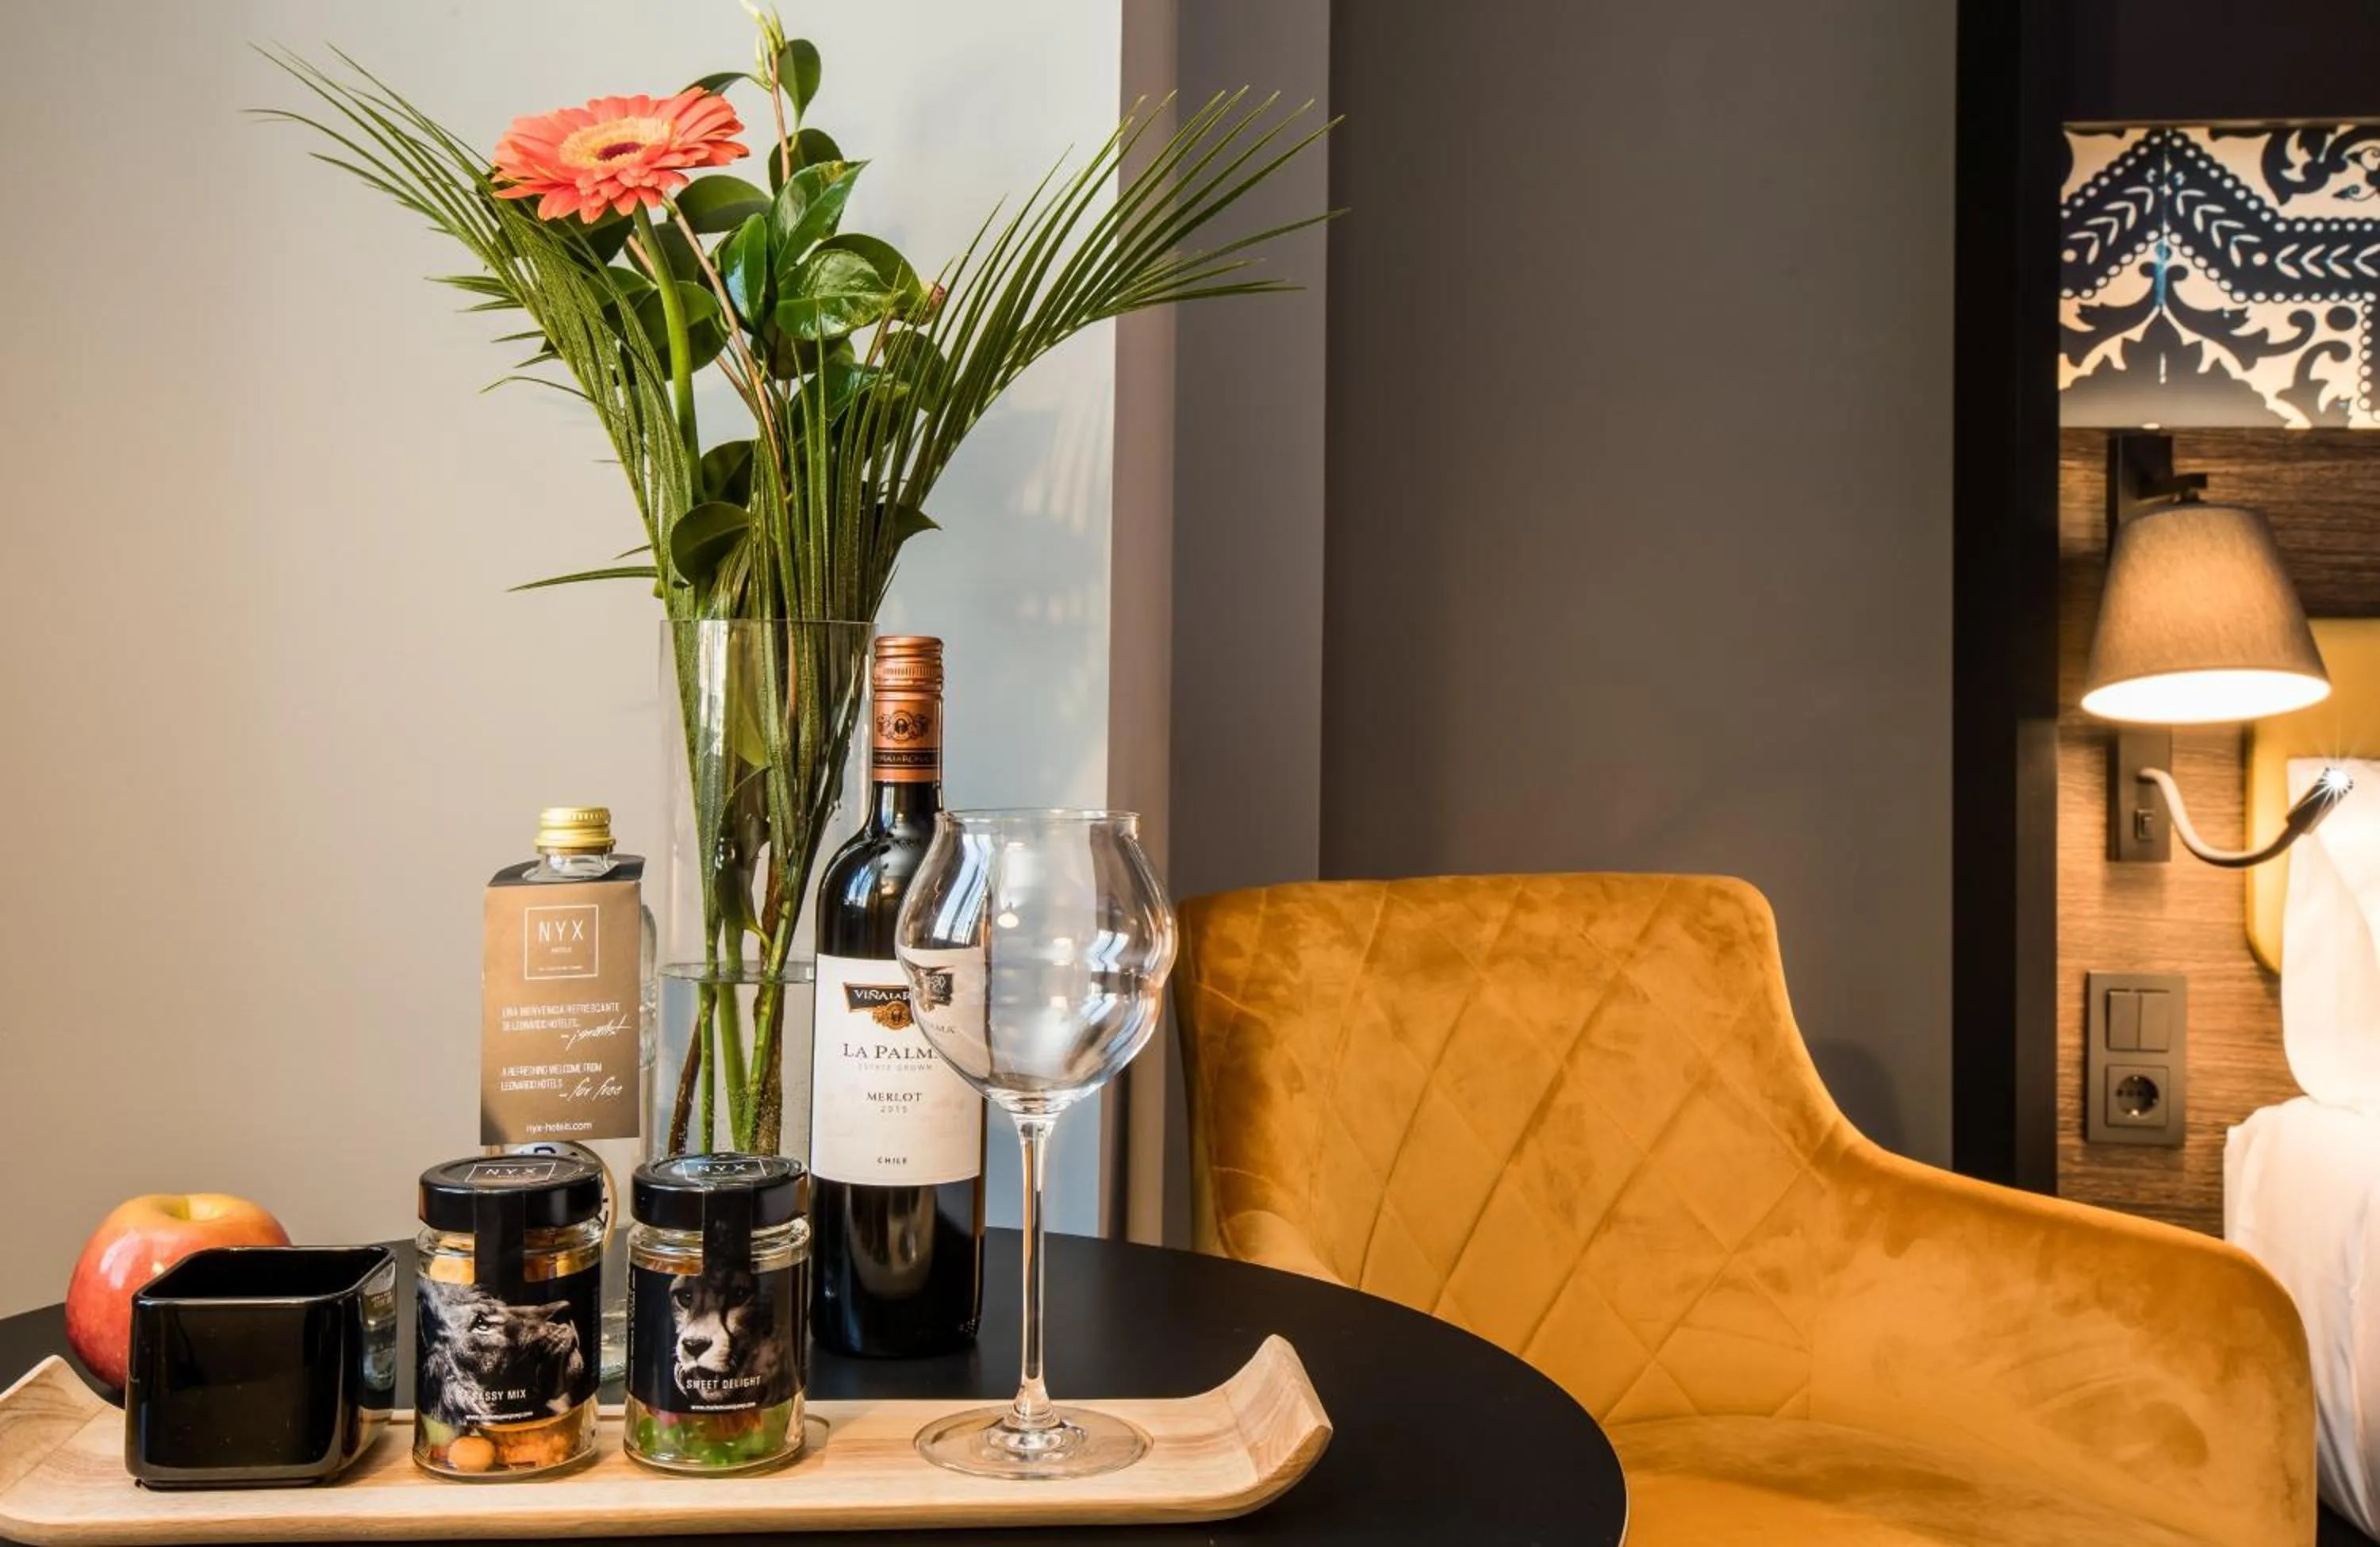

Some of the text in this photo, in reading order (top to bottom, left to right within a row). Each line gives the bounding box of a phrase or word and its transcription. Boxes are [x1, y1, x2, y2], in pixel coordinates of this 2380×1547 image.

[539, 919, 583, 942] NYX
[843, 1043, 939, 1059] LA PALM
[866, 1092, 923, 1101] MERLOT
[526, 1122, 593, 1133] nyx-hotels.com
[877, 1156, 908, 1165] CHILE
[486, 1167, 537, 1176] NYX
[686, 1376, 762, 1389] SWEET DELIGHT
[508, 1389, 526, 1400] MIX
